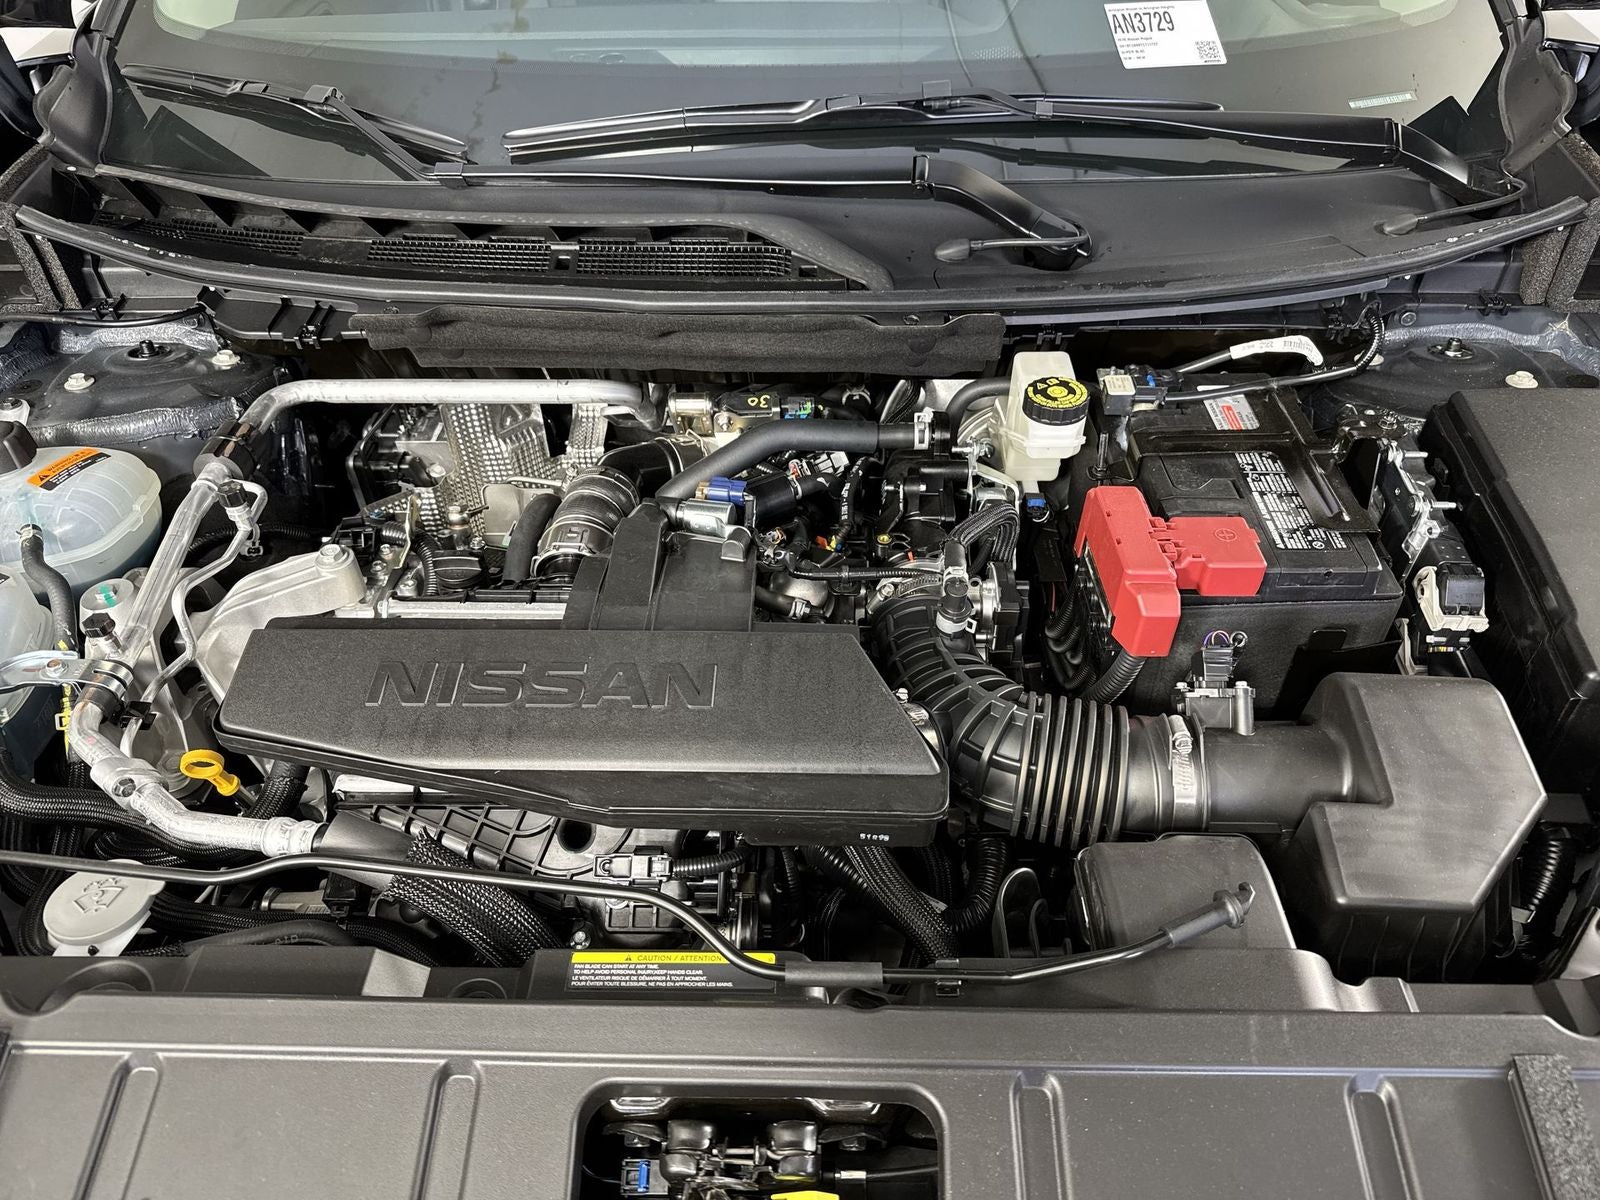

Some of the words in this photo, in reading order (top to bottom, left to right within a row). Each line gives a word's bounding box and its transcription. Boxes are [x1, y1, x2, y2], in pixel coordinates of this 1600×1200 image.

[1112, 11, 1175, 34] AN3729
[365, 661, 718, 709] NISSAN
[637, 954, 672, 962] CAUTION
[679, 954, 722, 962] ATTENTION
